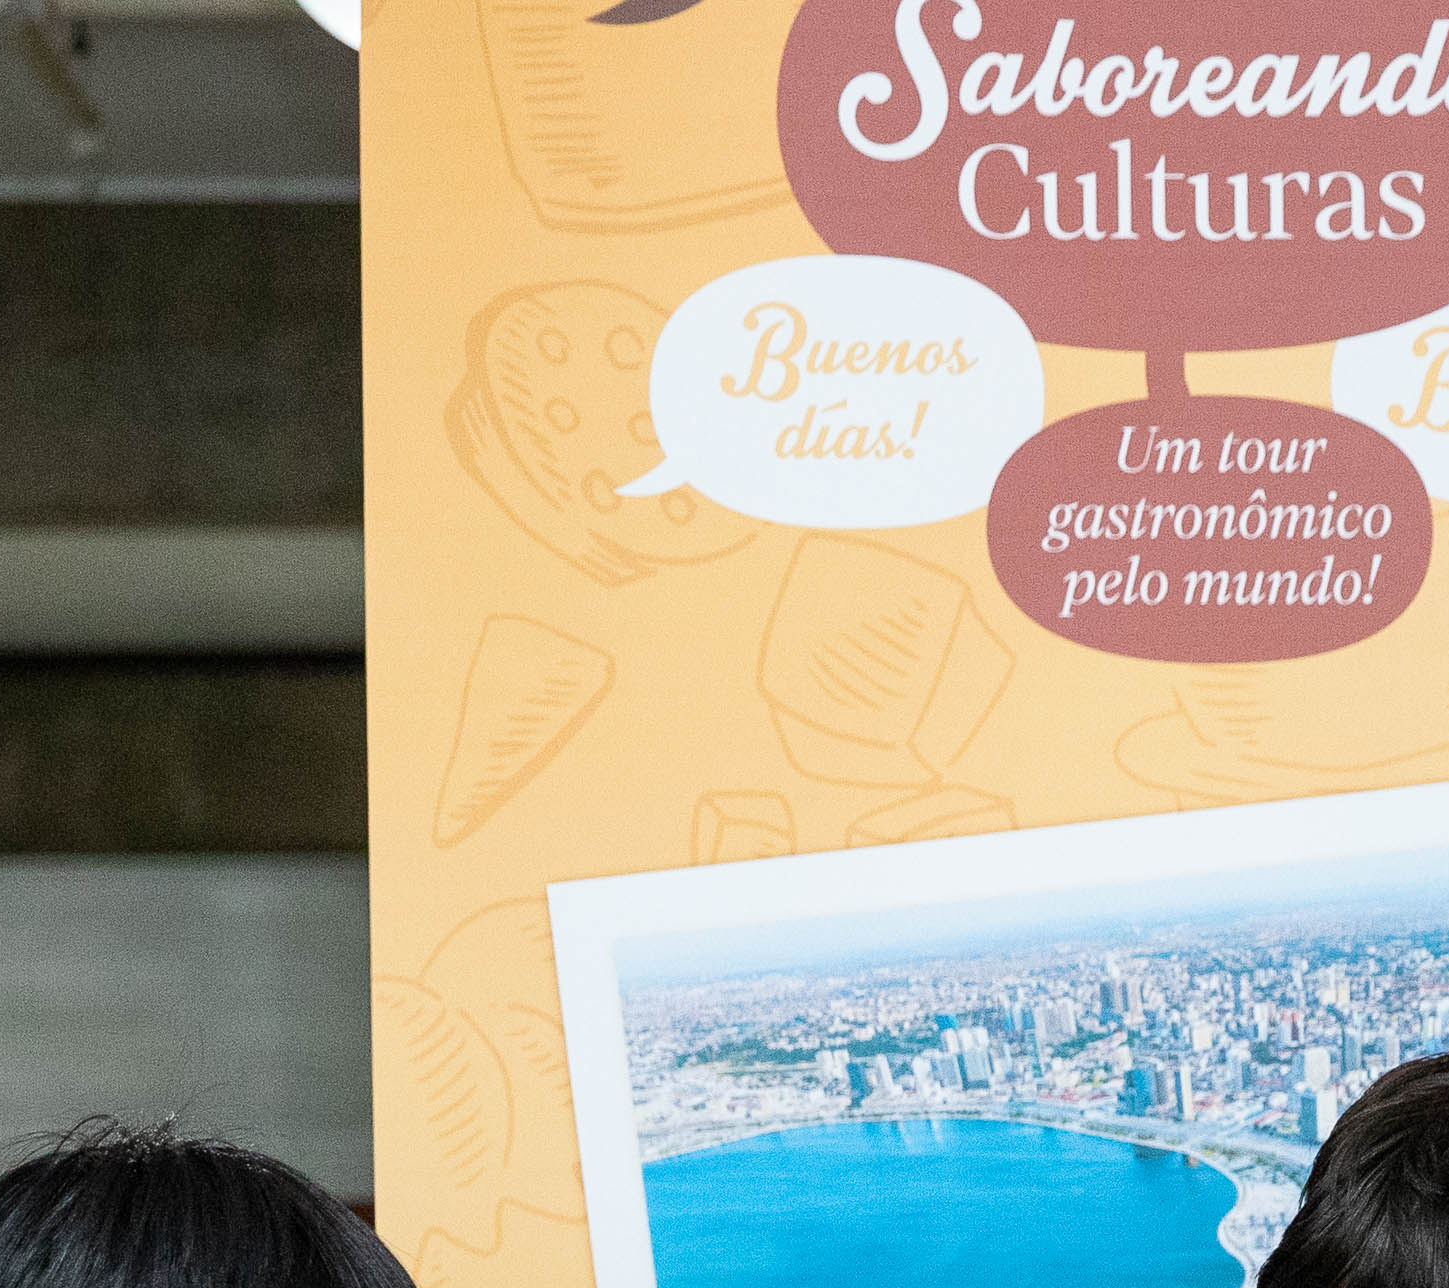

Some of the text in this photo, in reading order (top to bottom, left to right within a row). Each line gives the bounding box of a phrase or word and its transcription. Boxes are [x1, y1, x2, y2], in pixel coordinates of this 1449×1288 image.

[958, 138, 1426, 241] Culturas
[720, 302, 979, 401] Buenos
[774, 399, 929, 460] días!
[1116, 425, 1327, 474] Um tour
[1041, 489, 1392, 553] gastronômico
[1059, 555, 1382, 618] pelo mundo!
